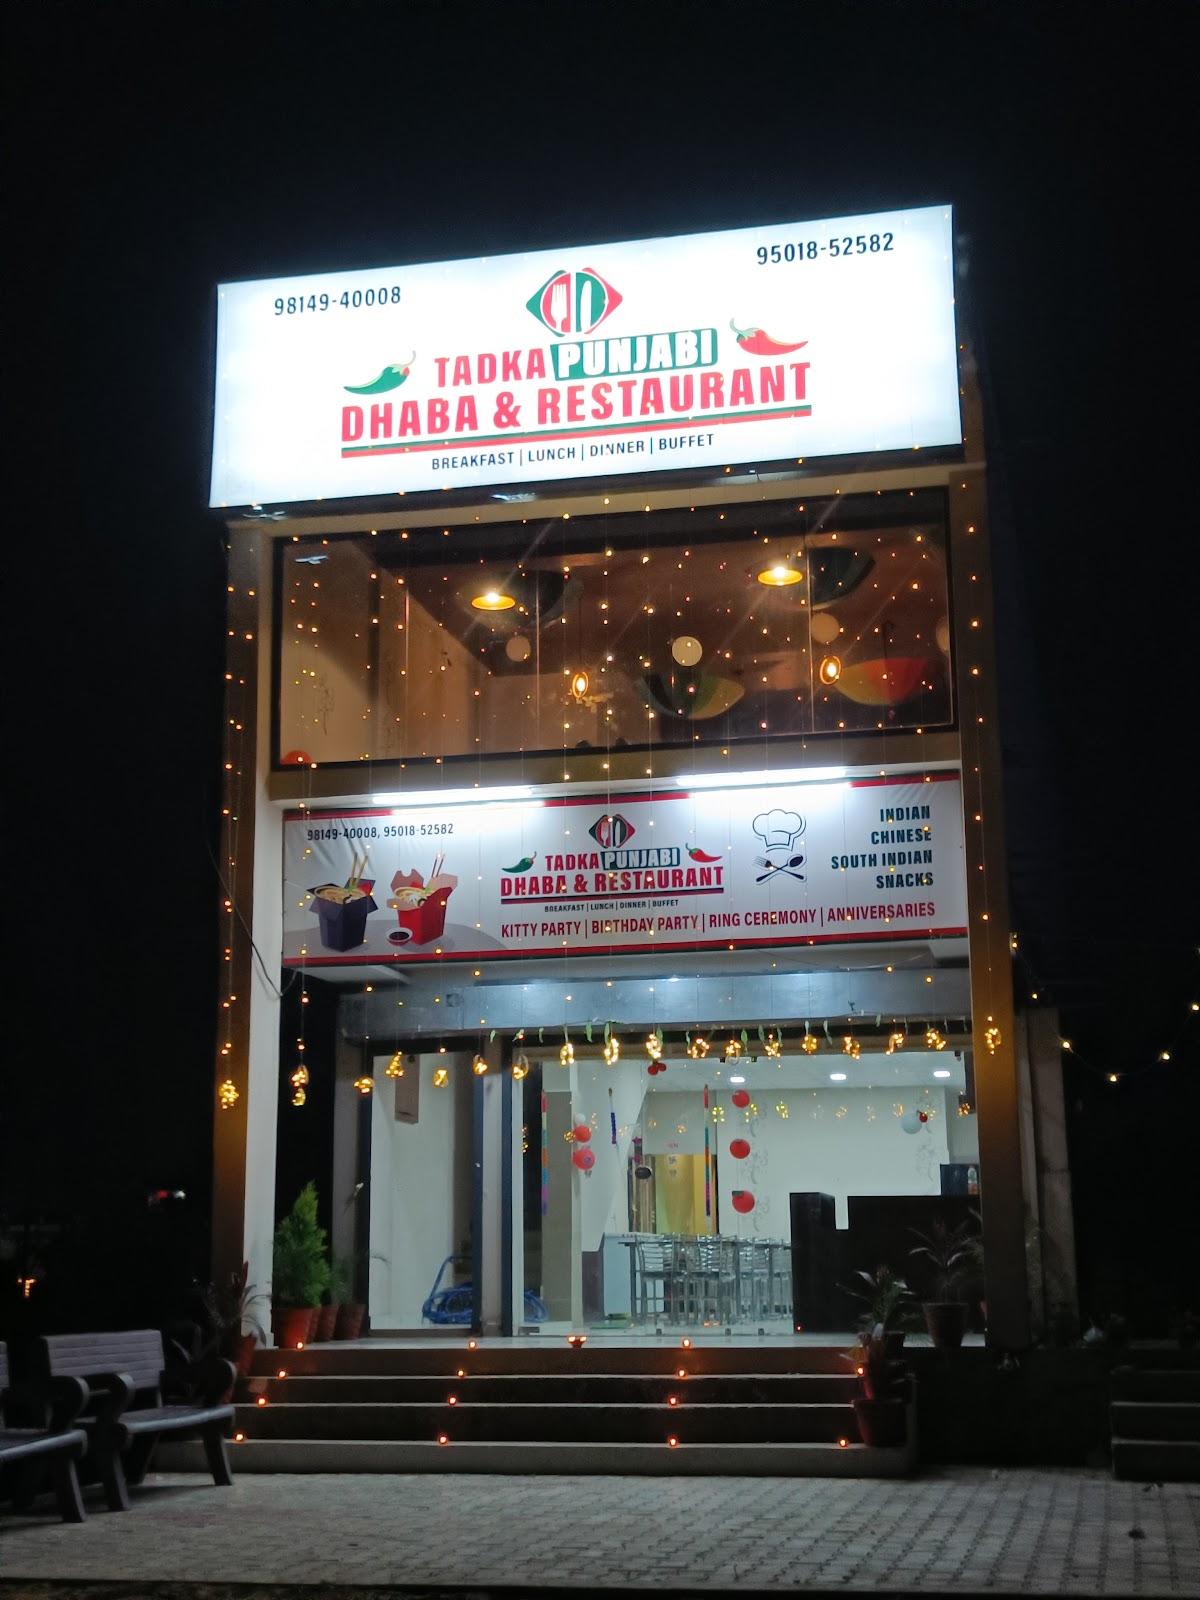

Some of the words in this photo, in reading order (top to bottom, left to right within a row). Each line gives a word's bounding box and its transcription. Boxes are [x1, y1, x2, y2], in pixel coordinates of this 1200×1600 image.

[757, 232, 894, 265] 95018-52582
[274, 286, 401, 316] 98149-40008
[434, 348, 546, 388] TADKA
[557, 329, 713, 379] PUNJABI
[341, 395, 478, 442] DHABA
[493, 391, 522, 429] &
[538, 362, 811, 425] RESTAURANT
[432, 451, 515, 470] BREAKFAST
[528, 446, 576, 462] LUNCH
[590, 441, 645, 457] DINNER
[659, 434, 715, 450] BUFFET
[880, 805, 931, 822] INDIAN
[384, 823, 454, 838] 95018-52582
[871, 828, 932, 845] CHINESE
[545, 852, 599, 872] TADKA
[603, 848, 679, 869] PUNJABI
[831, 854, 878, 870] SOUTH
[882, 850, 933, 867] INDIAN
[500, 875, 569, 897] DHABA
[574, 874, 588, 893] &
[595, 866, 724, 893] RESTAURANT
[876, 872, 933, 889] SNACKS
[544, 904, 585, 913] BREAKFAST
[590, 902, 614, 911] LUNCH
[620, 901, 647, 909] DINNER
[652, 899, 679, 908] BUFFET
[501, 923, 538, 938] KITTY
[541, 921, 581, 937] PARTY
[592, 917, 653, 934] BIRTHDAY
[658, 915, 698, 931] PARTY
[709, 912, 740, 928] RING
[744, 908, 817, 926] CEREMONY
[827, 902, 936, 922] ANNIVERSARIES
